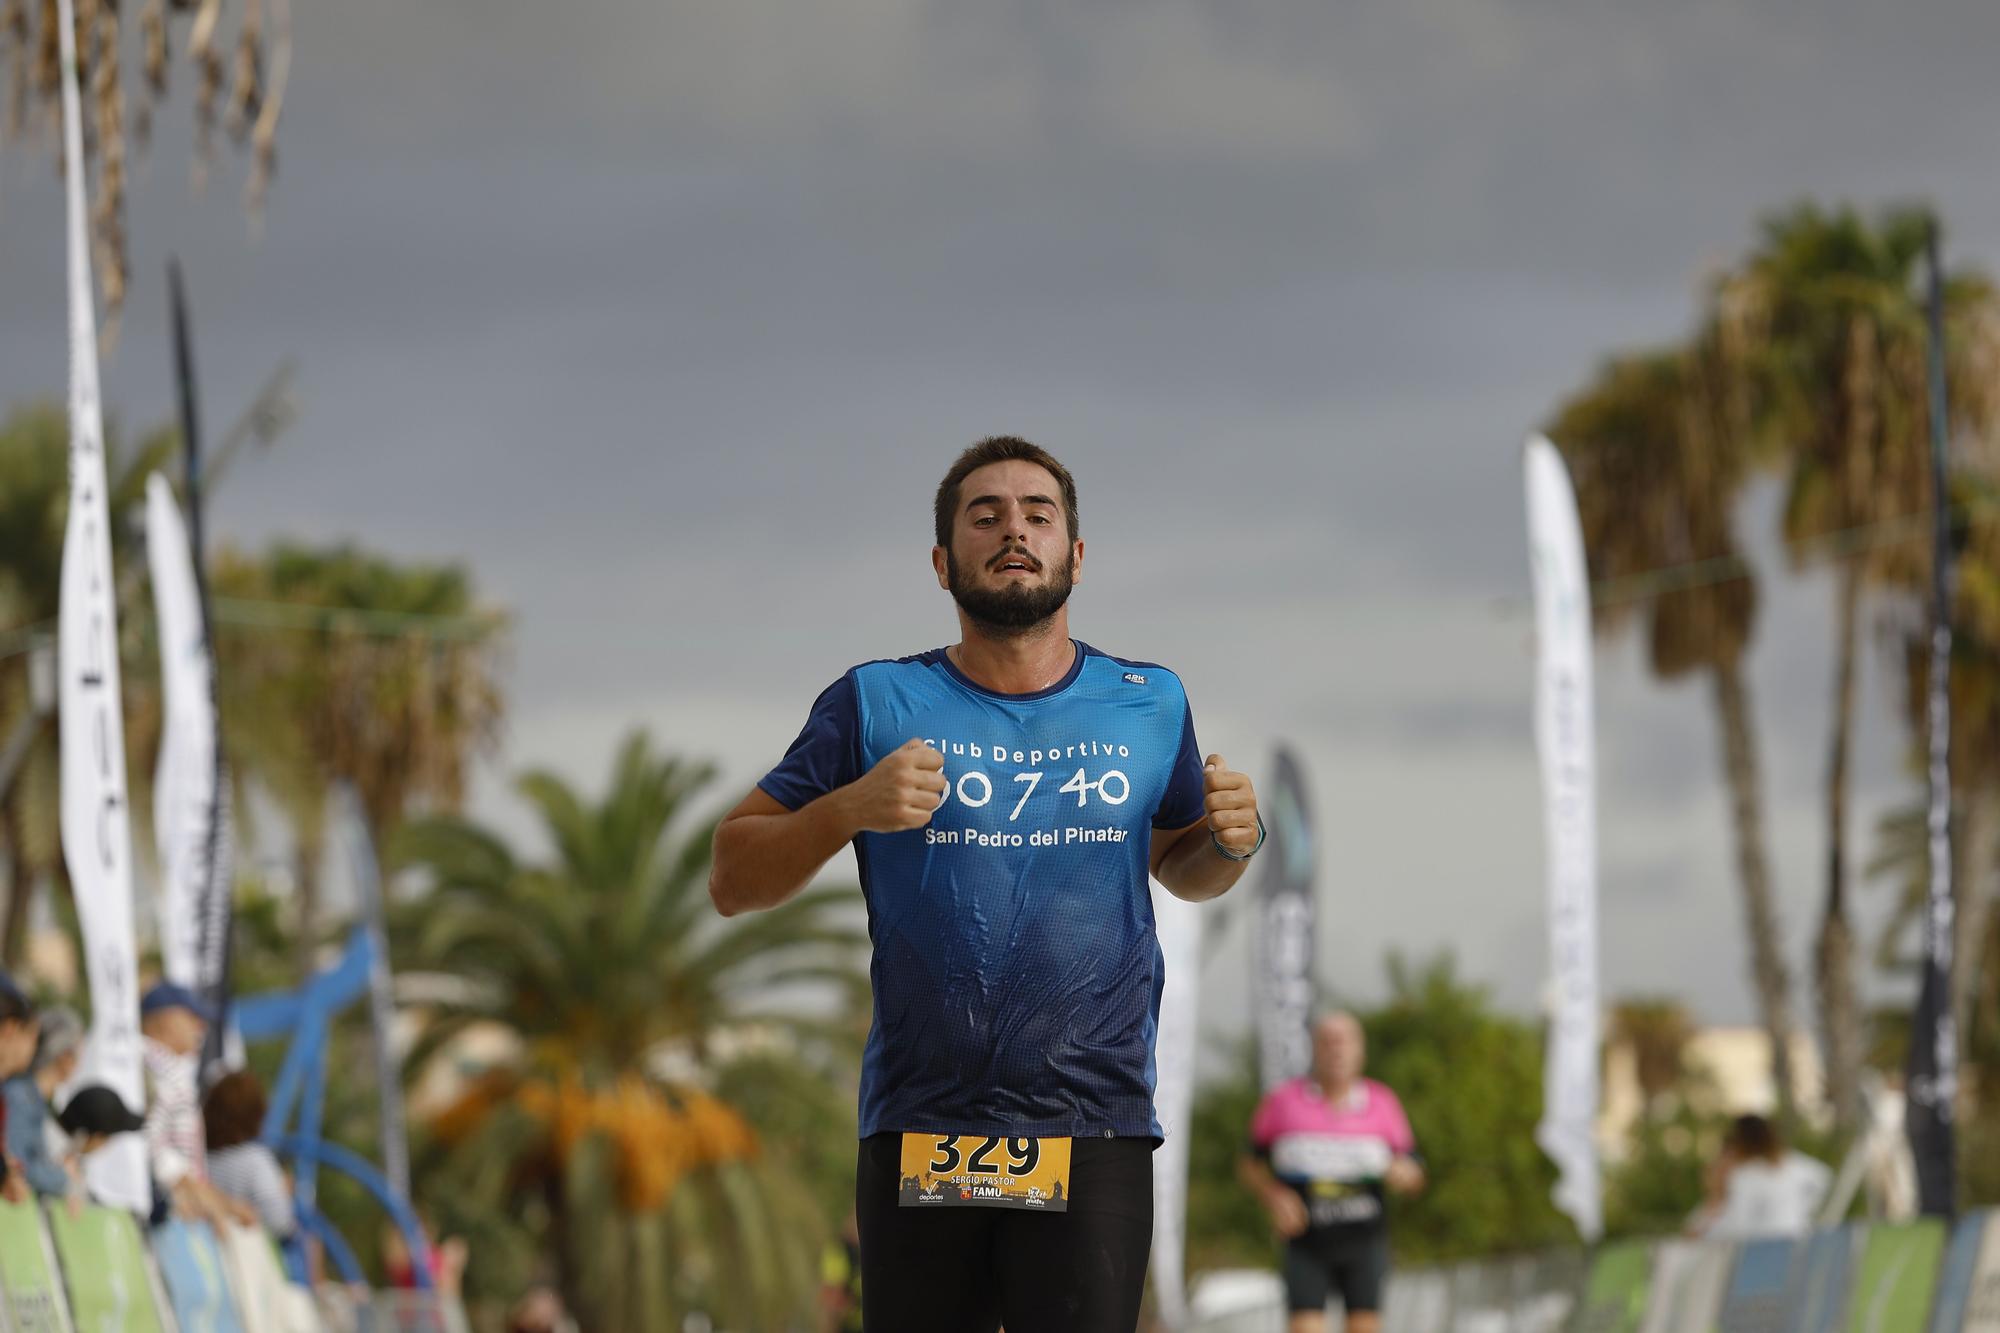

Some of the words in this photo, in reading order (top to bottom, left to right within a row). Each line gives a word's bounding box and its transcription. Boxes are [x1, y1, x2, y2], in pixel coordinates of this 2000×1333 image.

[993, 741, 1129, 766] Deportivo
[925, 828, 959, 844] San
[965, 828, 1023, 847] Pedro
[1029, 829, 1059, 846] del
[1065, 826, 1128, 844] Pinatar
[930, 1135, 1040, 1178] 329
[951, 1175, 980, 1184] SERGIO
[982, 1176, 1015, 1186] PASTOR
[972, 1186, 1002, 1198] FAMU
